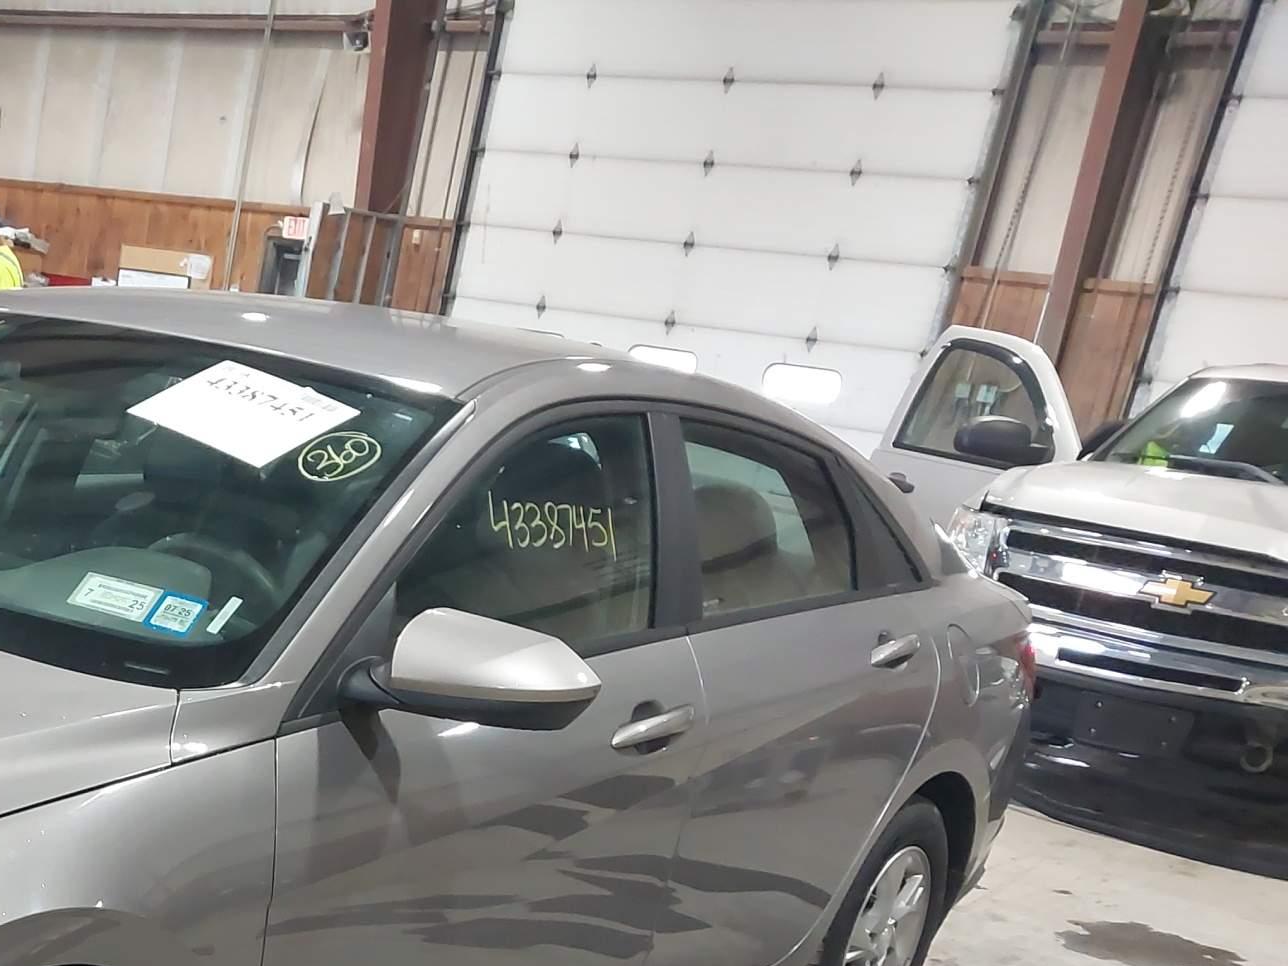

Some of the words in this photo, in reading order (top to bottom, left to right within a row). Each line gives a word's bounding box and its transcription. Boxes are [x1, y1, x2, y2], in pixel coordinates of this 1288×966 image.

[287, 217, 307, 236] EXIT
[207, 378, 314, 421] 43387451
[488, 489, 617, 563] 43387451
[128, 599, 146, 611] 25
